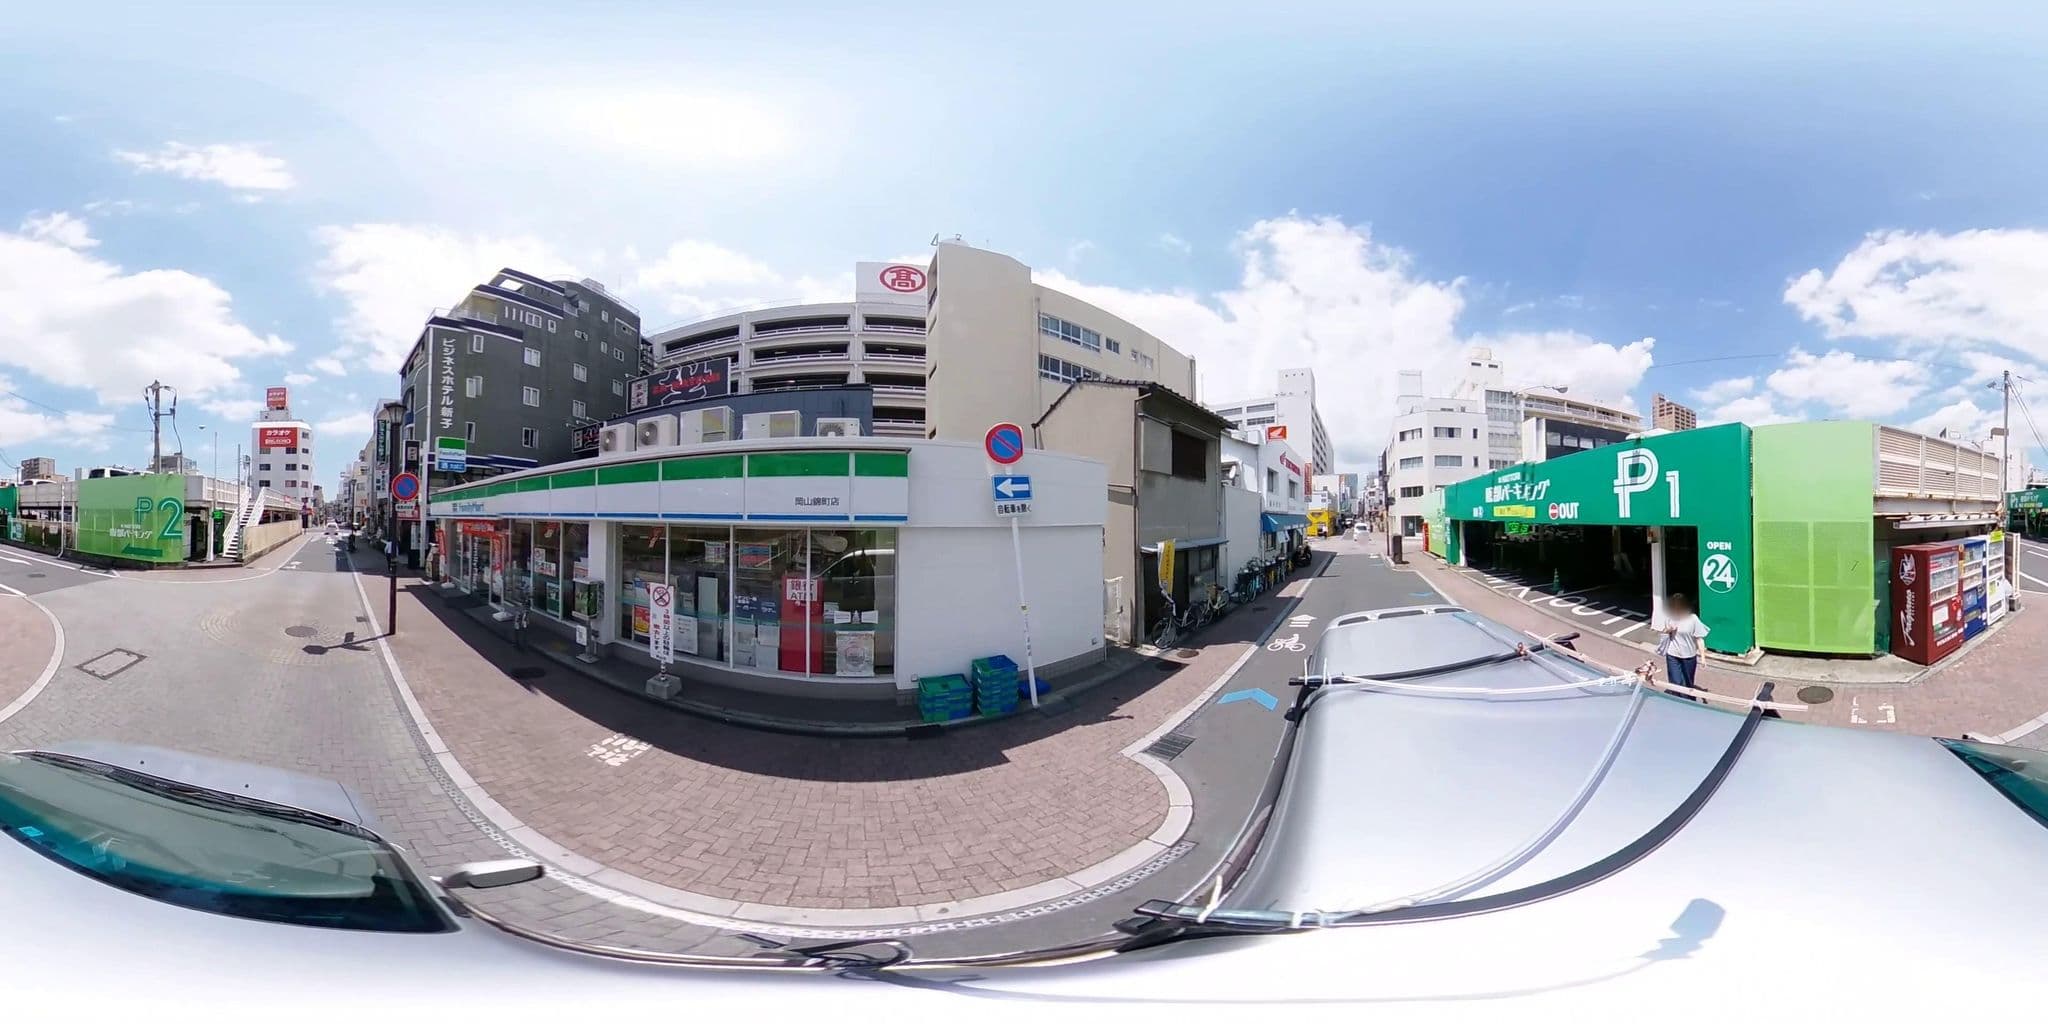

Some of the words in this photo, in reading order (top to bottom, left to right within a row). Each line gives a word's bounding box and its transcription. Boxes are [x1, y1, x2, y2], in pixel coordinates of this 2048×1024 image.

[1613, 447, 1680, 518] P1
[795, 496, 839, 506] 岡山錦町店
[997, 503, 1033, 515] 自転車を除く
[135, 496, 183, 541] P2
[1558, 502, 1580, 519] OUT
[1706, 541, 1731, 550] OPEN
[1706, 557, 1735, 588] 24
